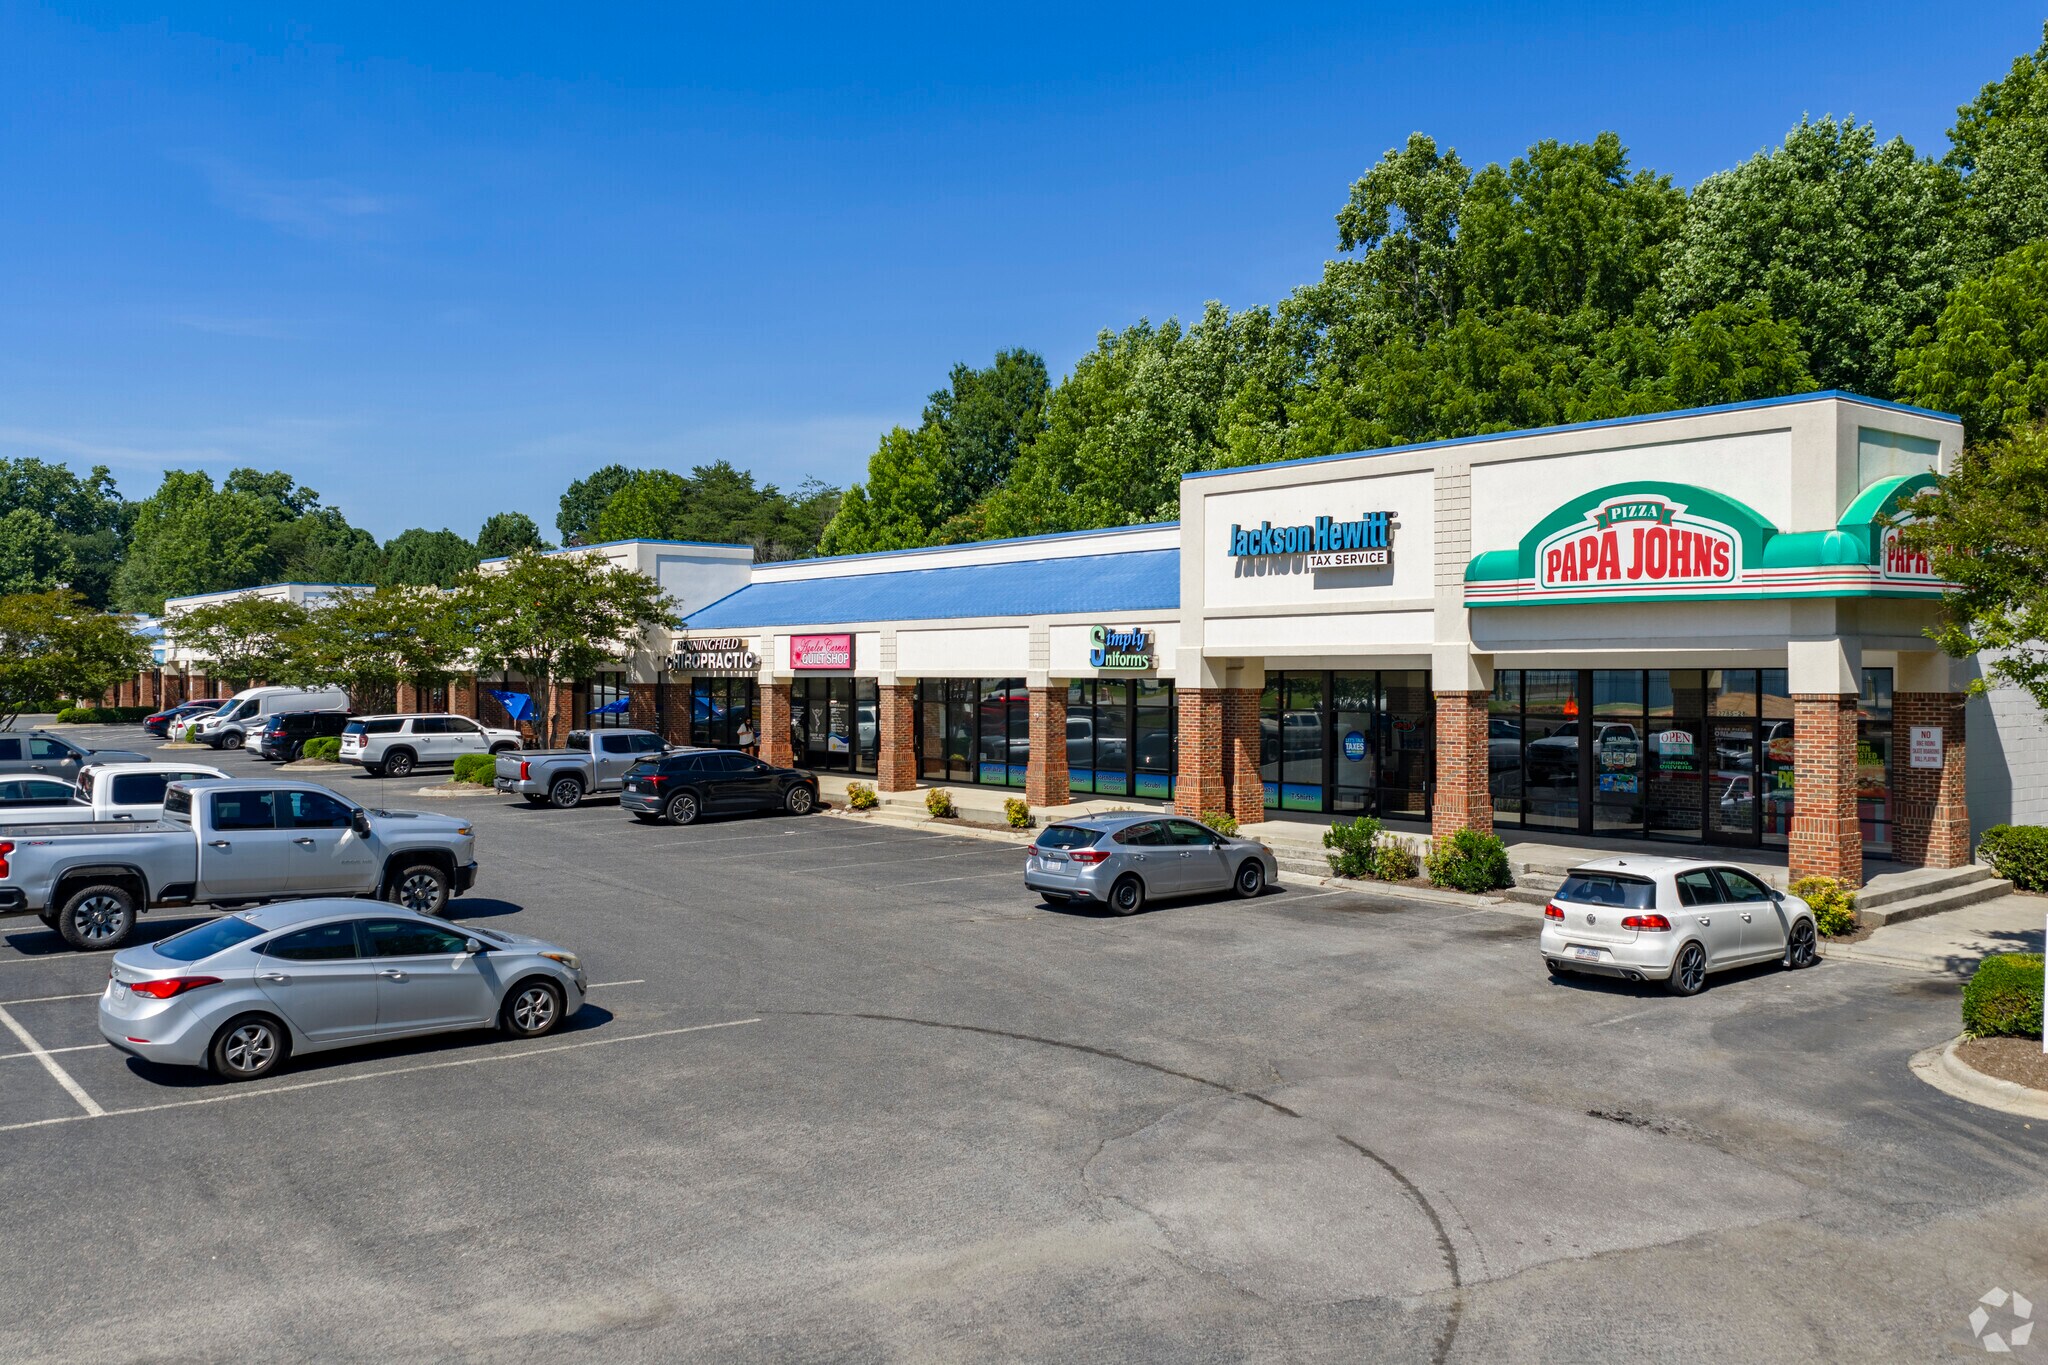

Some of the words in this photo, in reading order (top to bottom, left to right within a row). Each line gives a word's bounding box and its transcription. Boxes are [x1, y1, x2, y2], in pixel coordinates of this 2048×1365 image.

[1611, 504, 1658, 520] PIZZA
[1228, 520, 1313, 557] Jackson
[1314, 511, 1388, 551] Hewitt
[1310, 553, 1332, 567] TAX
[1335, 551, 1385, 565] SERVICE
[1546, 530, 1622, 583] PAPA
[1627, 527, 1730, 580] JOHN'S
[676, 638, 739, 651] BENNINGFIELD
[824, 638, 848, 653] Corner
[1090, 624, 1146, 652] Simply
[665, 651, 753, 670] CHIROPRACTIC
[801, 652, 826, 665] QUILT
[826, 652, 849, 665] SHOP
[1089, 649, 1149, 670] Uniforms
[1661, 731, 1691, 743] OPEN
[1921, 730, 1931, 739] NO
[1345, 742, 1365, 750] TAXES
[1144, 781, 1161, 789] Scrubs
[1291, 793, 1315, 801] T-Shirts
